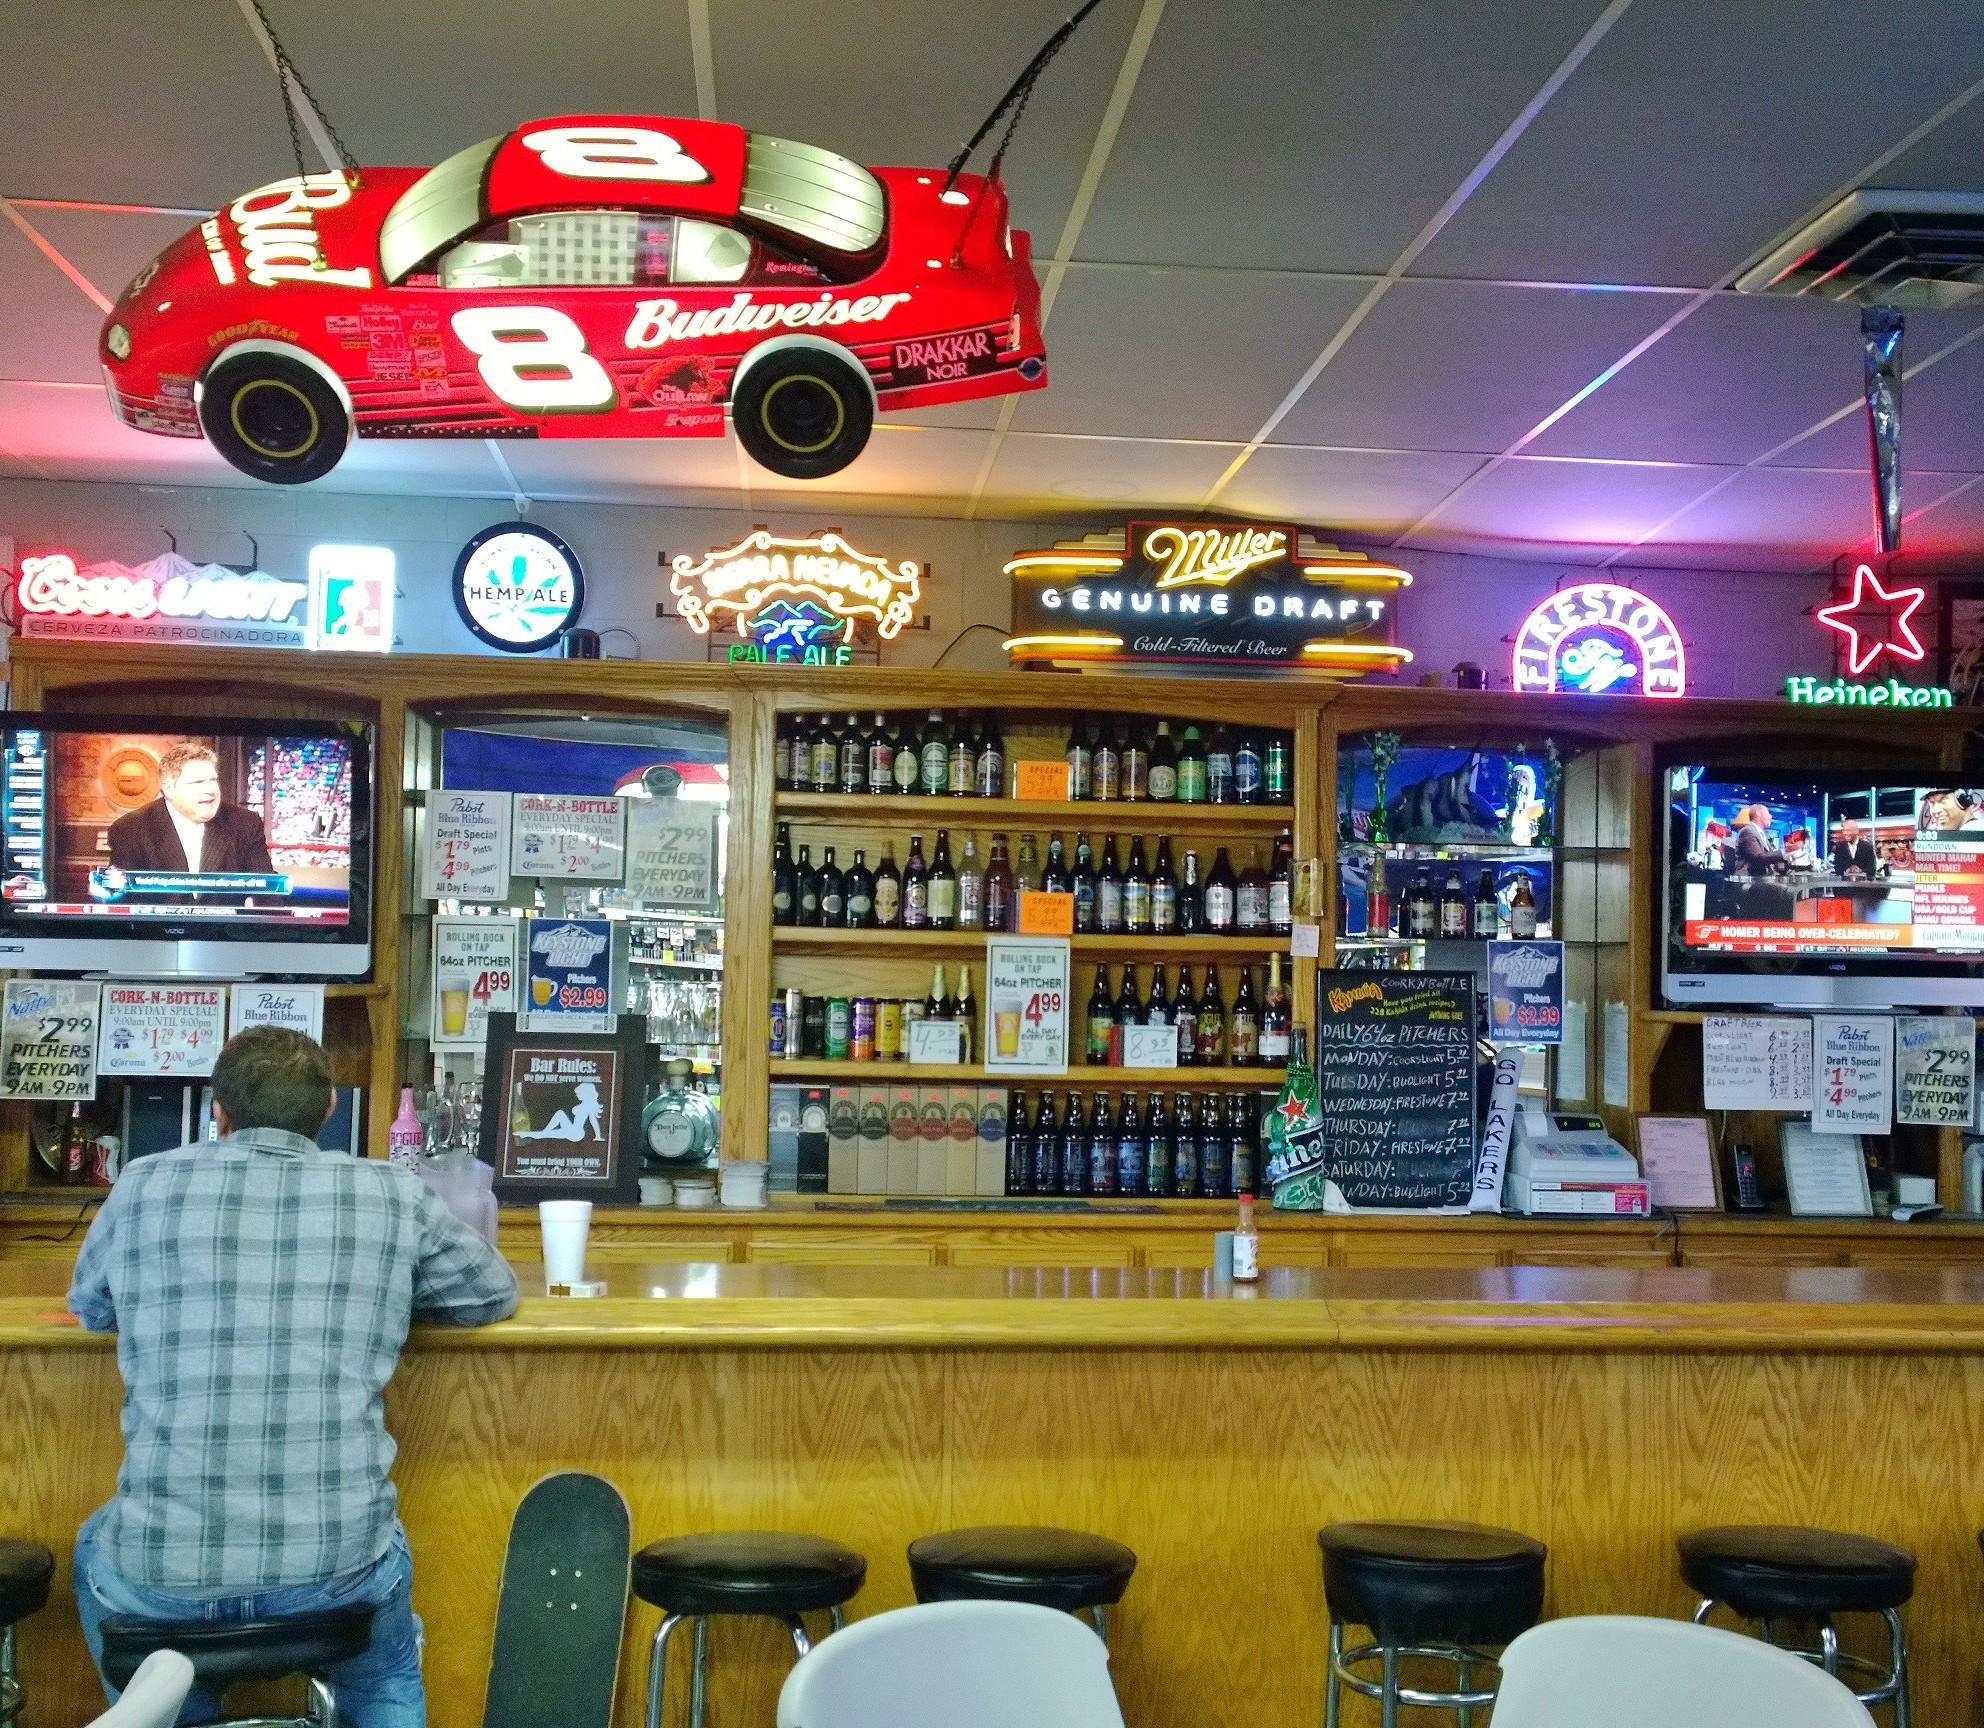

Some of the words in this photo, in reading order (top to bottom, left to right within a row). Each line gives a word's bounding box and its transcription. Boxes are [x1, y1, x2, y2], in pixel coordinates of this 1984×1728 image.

[522, 127, 714, 184] 8
[624, 291, 912, 349] Budweiser
[896, 332, 992, 369] DRAKKAR
[450, 305, 619, 414] 8
[926, 361, 968, 381] NOIR
[1146, 527, 1287, 588] Miller
[470, 586, 525, 601] HEMP
[533, 588, 568, 603] ALE
[1041, 588, 1230, 615] GENUINE
[1254, 596, 1385, 621] DRAFT
[29, 620, 122, 637] CERVEZA
[133, 624, 302, 643] PATROCINADORA
[1518, 590, 1680, 689] FIRESTONE
[1133, 635, 1245, 656] Cold-Filtered
[1248, 640, 1288, 656] Beer
[728, 644, 793, 666] PALE
[803, 644, 853, 667] ALE
[1787, 676, 1953, 708] Heineken
[451, 797, 485, 813] Pabst
[437, 829, 460, 839] Draft
[464, 830, 498, 841] Special
[632, 867, 706, 881] EVERYDAY
[1721, 927, 1760, 939] HOMER
[440, 955, 465, 967] 64oz
[467, 956, 511, 968] PITCHER
[1020, 978, 1062, 989] PITCHER
[110, 990, 218, 1005] CORK-N-BOTTLE
[257, 993, 295, 1010] Pabst
[559, 985, 607, 1009] $2.99
[109, 1005, 167, 1016] EVERYDAY
[169, 1006, 217, 1016] SPECIAL!
[244, 1010, 268, 1020] Blue
[269, 1010, 307, 1022] Ribbon
[1518, 1004, 1560, 1027] $2.99
[147, 1017, 177, 1027] UNTIL
[1837, 1025, 1871, 1041] Pabst
[10, 1043, 92, 1058] PITCHERS
[1826, 1040, 1848, 1051] Blue
[1849, 1041, 1881, 1052] Ribbon
[6, 1062, 90, 1077] EVERYDAY
[531, 1057, 555, 1073] Bar
[557, 1058, 597, 1074] Rules:
[1826, 1055, 1848, 1065] Draft
[1851, 1056, 1881, 1068] Special
[53, 1080, 90, 1095] 9PM
[1903, 1073, 1970, 1088] PITCHERS
[1901, 1089, 1969, 1104] EVERYDAY
[1825, 1110, 1835, 1119] All
[1836, 1111, 1850, 1121] Day
[1851, 1111, 1880, 1122] Everyday
[1938, 1106, 1969, 1121] 9PM
[390, 1131, 424, 1146] ROGUE
[1476, 1099, 1508, 1190] LAKERS
